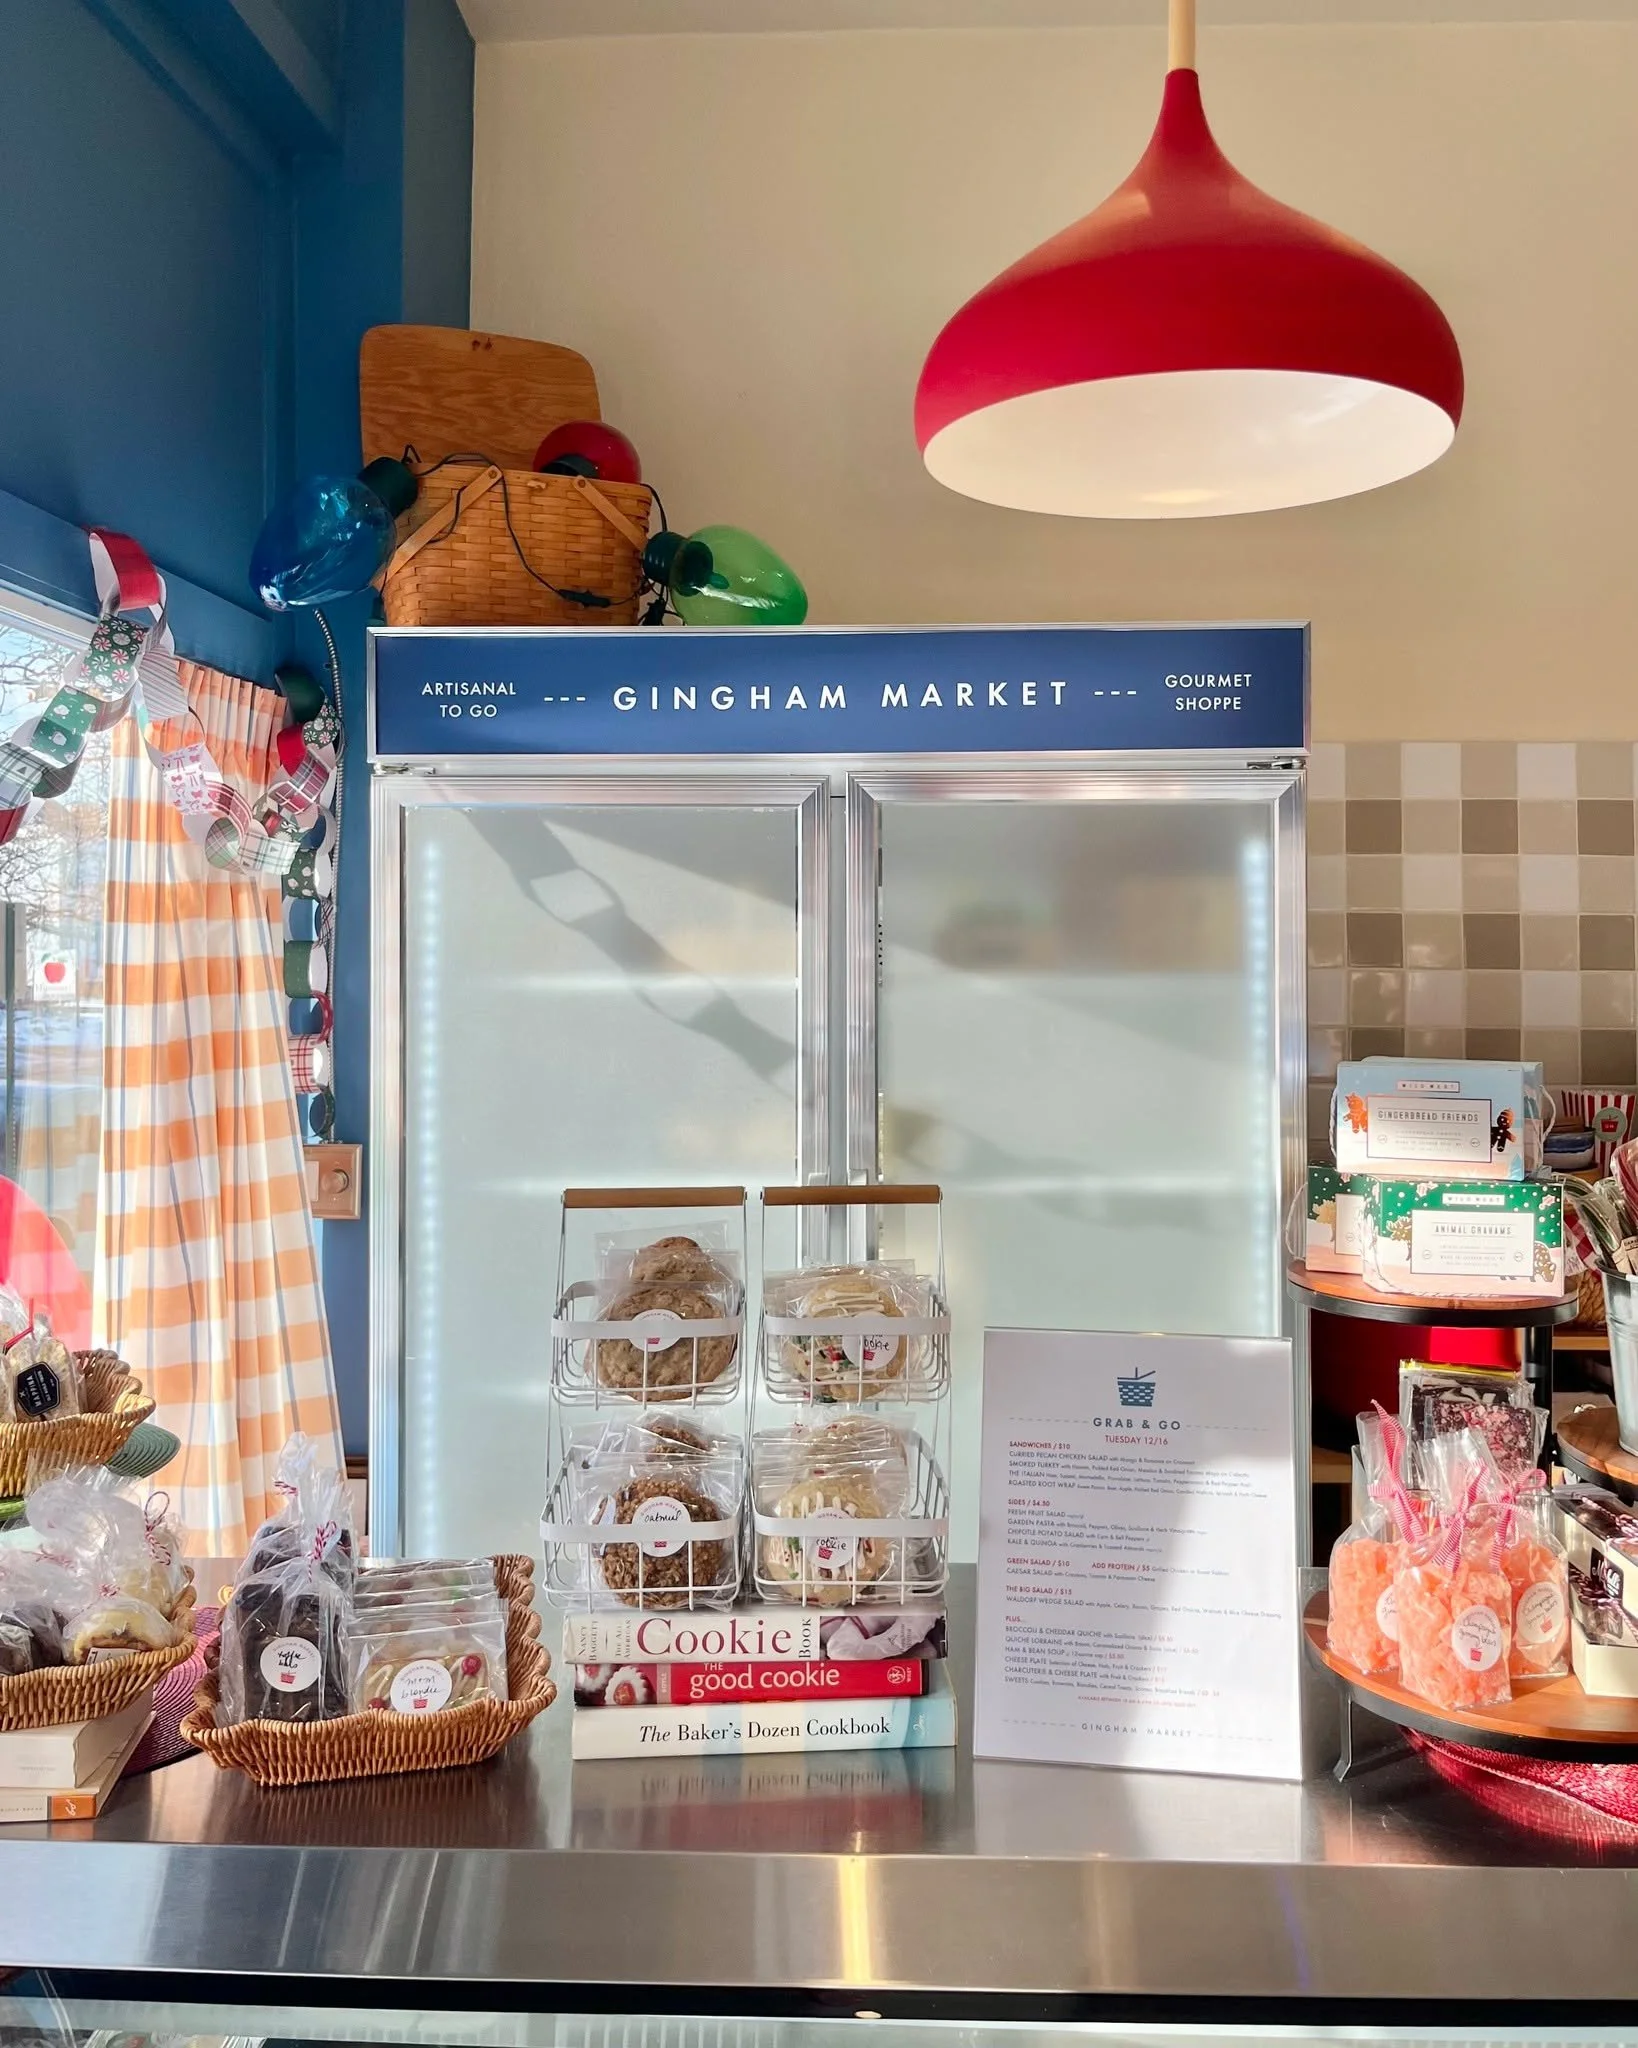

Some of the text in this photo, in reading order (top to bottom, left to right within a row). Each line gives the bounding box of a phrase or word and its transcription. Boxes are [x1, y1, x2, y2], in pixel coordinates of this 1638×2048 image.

[1164, 673, 1252, 689] GOURMET
[421, 682, 516, 696] ARTISANAL
[613, 681, 1067, 711] GINGHAM MARKET
[1175, 697, 1241, 711] SHOPPE
[439, 704, 498, 718] TO GO
[1378, 1110, 1479, 1122] GINGERBREAD FRIENDS
[1435, 1225, 1512, 1235] ANIMAL GRAHAMS
[1093, 1417, 1181, 1430] GRAB & GO
[1009, 1440, 1052, 1449] SANDWICHES
[1058, 1442, 1071, 1450] $10
[1104, 1434, 1169, 1446] TUESDAY 12/16
[1009, 1450, 1036, 1458] CURRIED
[1036, 1451, 1058, 1459] PECAN
[1058, 1452, 1087, 1460] CHICKEN
[1009, 1460, 1036, 1468] SMOKED
[1037, 1461, 1060, 1469] TURKEY
[1021, 1470, 1045, 1478] ITALIAN
[1038, 1480, 1056, 1488] ROOT
[1008, 1498, 1026, 1506] SIDES
[644, 1509, 682, 1523] oatmeal
[1008, 1508, 1027, 1516] FRESH
[1046, 1510, 1066, 1518] SALAD
[1007, 1518, 1035, 1526] GARDEN
[1007, 1528, 1036, 1536] CHIPOTLE
[1038, 1529, 1063, 1537] POTATO
[1064, 1530, 1085, 1538] SALAD
[1030, 1558, 1051, 1566] SALAD
[1091, 1562, 1106, 1570] ADD
[1107, 1563, 1135, 1571] PROTEIN
[1032, 1568, 1053, 1576] SALAD
[1060, 1588, 1072, 1596] $15
[1038, 1597, 1062, 1605] WEDGE
[1063, 1598, 1084, 1606] SALAD
[637, 1617, 792, 1656] Cookie
[1005, 1626, 1038, 1634] BROCCOLI
[1045, 1628, 1075, 1637] CHEDDAR
[1077, 1630, 1101, 1638] QUICHE
[577, 1625, 588, 1657] NANCY
[588, 1620, 599, 1661] BAGGETT
[623, 1619, 632, 1659] AMERICAN
[797, 1617, 813, 1659] BOOK
[1005, 1636, 1029, 1644] QUICHE
[1031, 1638, 1062, 1646] LORRAINE
[1047, 1648, 1065, 1656] SOUP
[1004, 1656, 1028, 1664] CHEESE
[1029, 1657, 1047, 1665] PLATE
[703, 1662, 724, 1673] THE
[1054, 1669, 1078, 1677] CHEESE
[1080, 1671, 1098, 1679] PLATE
[690, 1661, 840, 1698] good cookie
[1004, 1676, 1029, 1684] SWEETS
[639, 1716, 892, 1744] The Baker's Dozen Cookbook
[1081, 1722, 1192, 1738] GINGHAM MARKET
